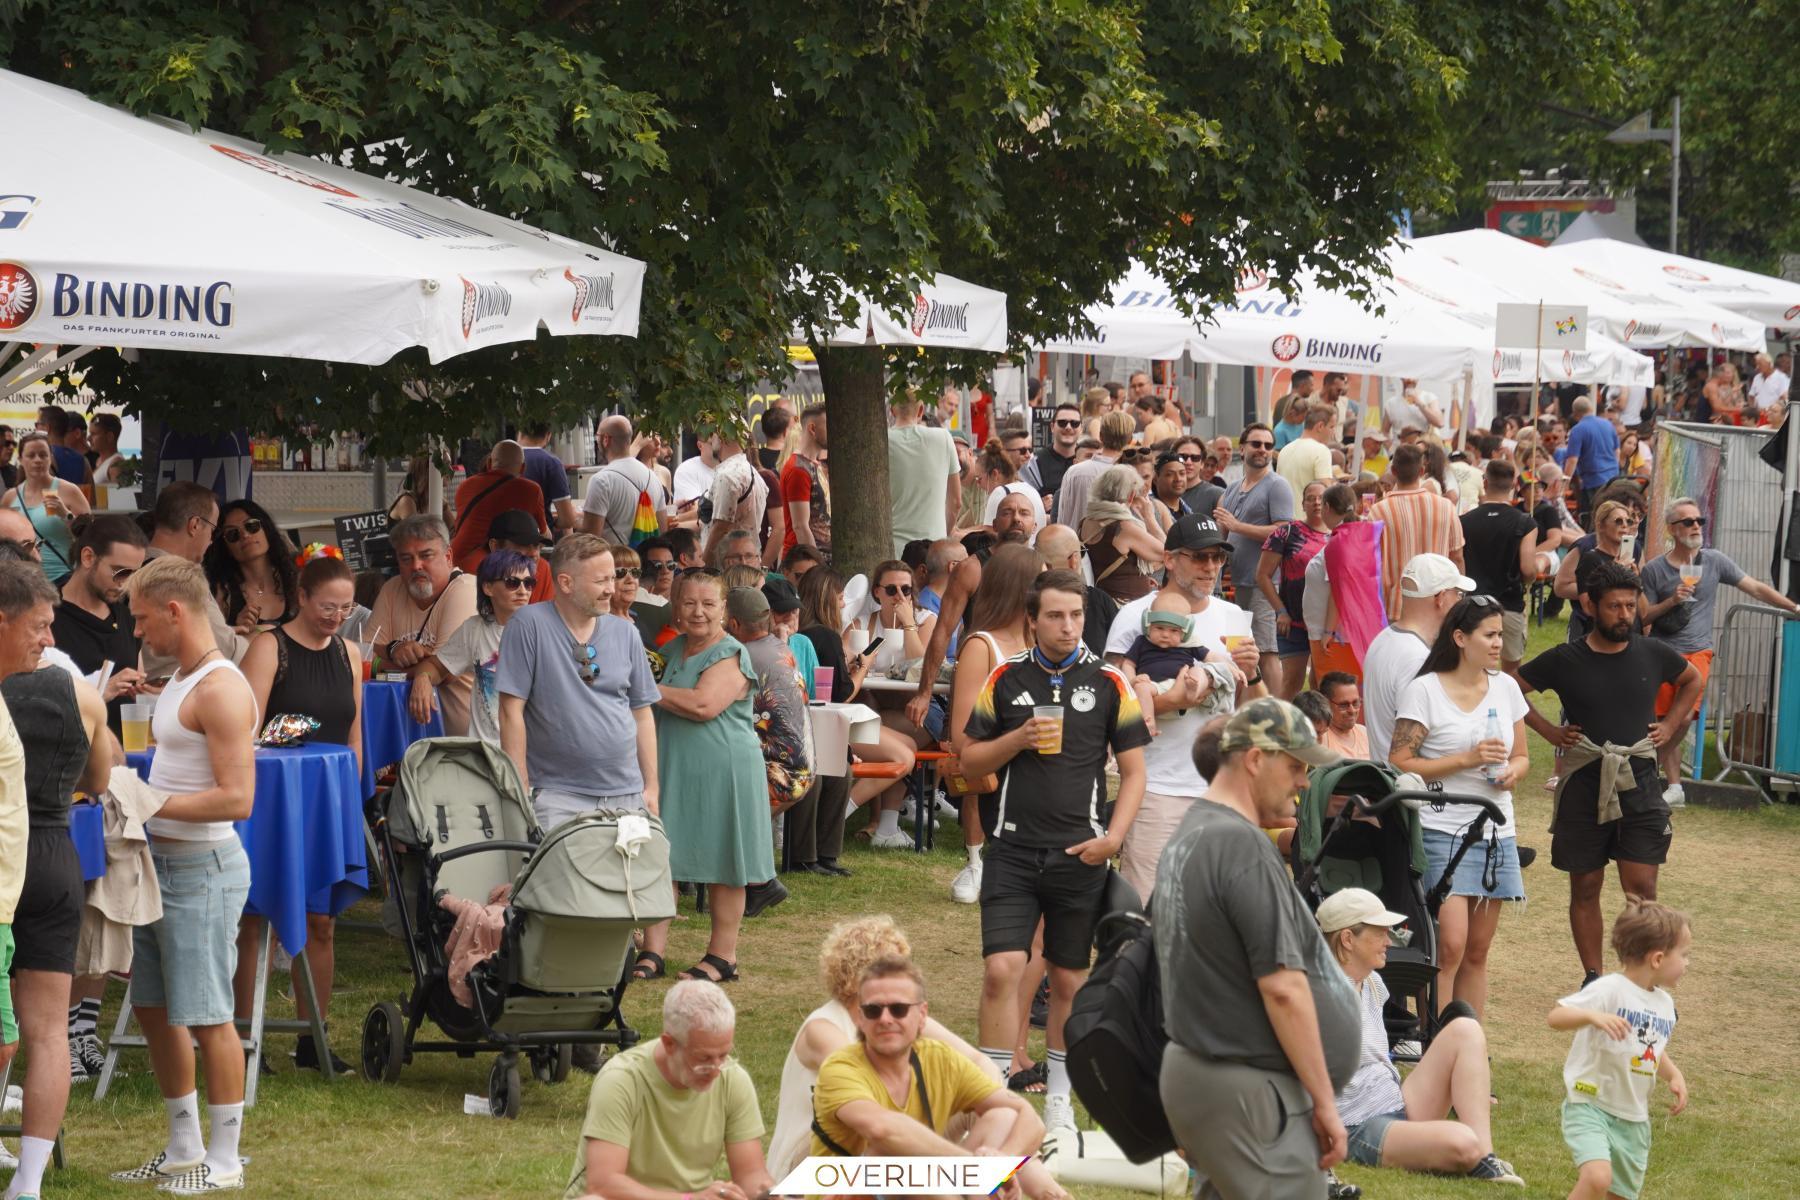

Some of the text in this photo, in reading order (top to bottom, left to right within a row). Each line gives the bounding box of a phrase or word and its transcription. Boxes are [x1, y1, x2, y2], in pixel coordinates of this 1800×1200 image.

[53, 272, 232, 328] BINDING
[1119, 289, 1302, 317] BIING
[928, 299, 969, 332] BINDING
[88, 325, 166, 336] FRANKFURTER
[170, 330, 221, 340] ORIGINAL
[1306, 338, 1383, 363] BINDING
[1035, 408, 1055, 419] TWI
[342, 513, 386, 532] TWIS
